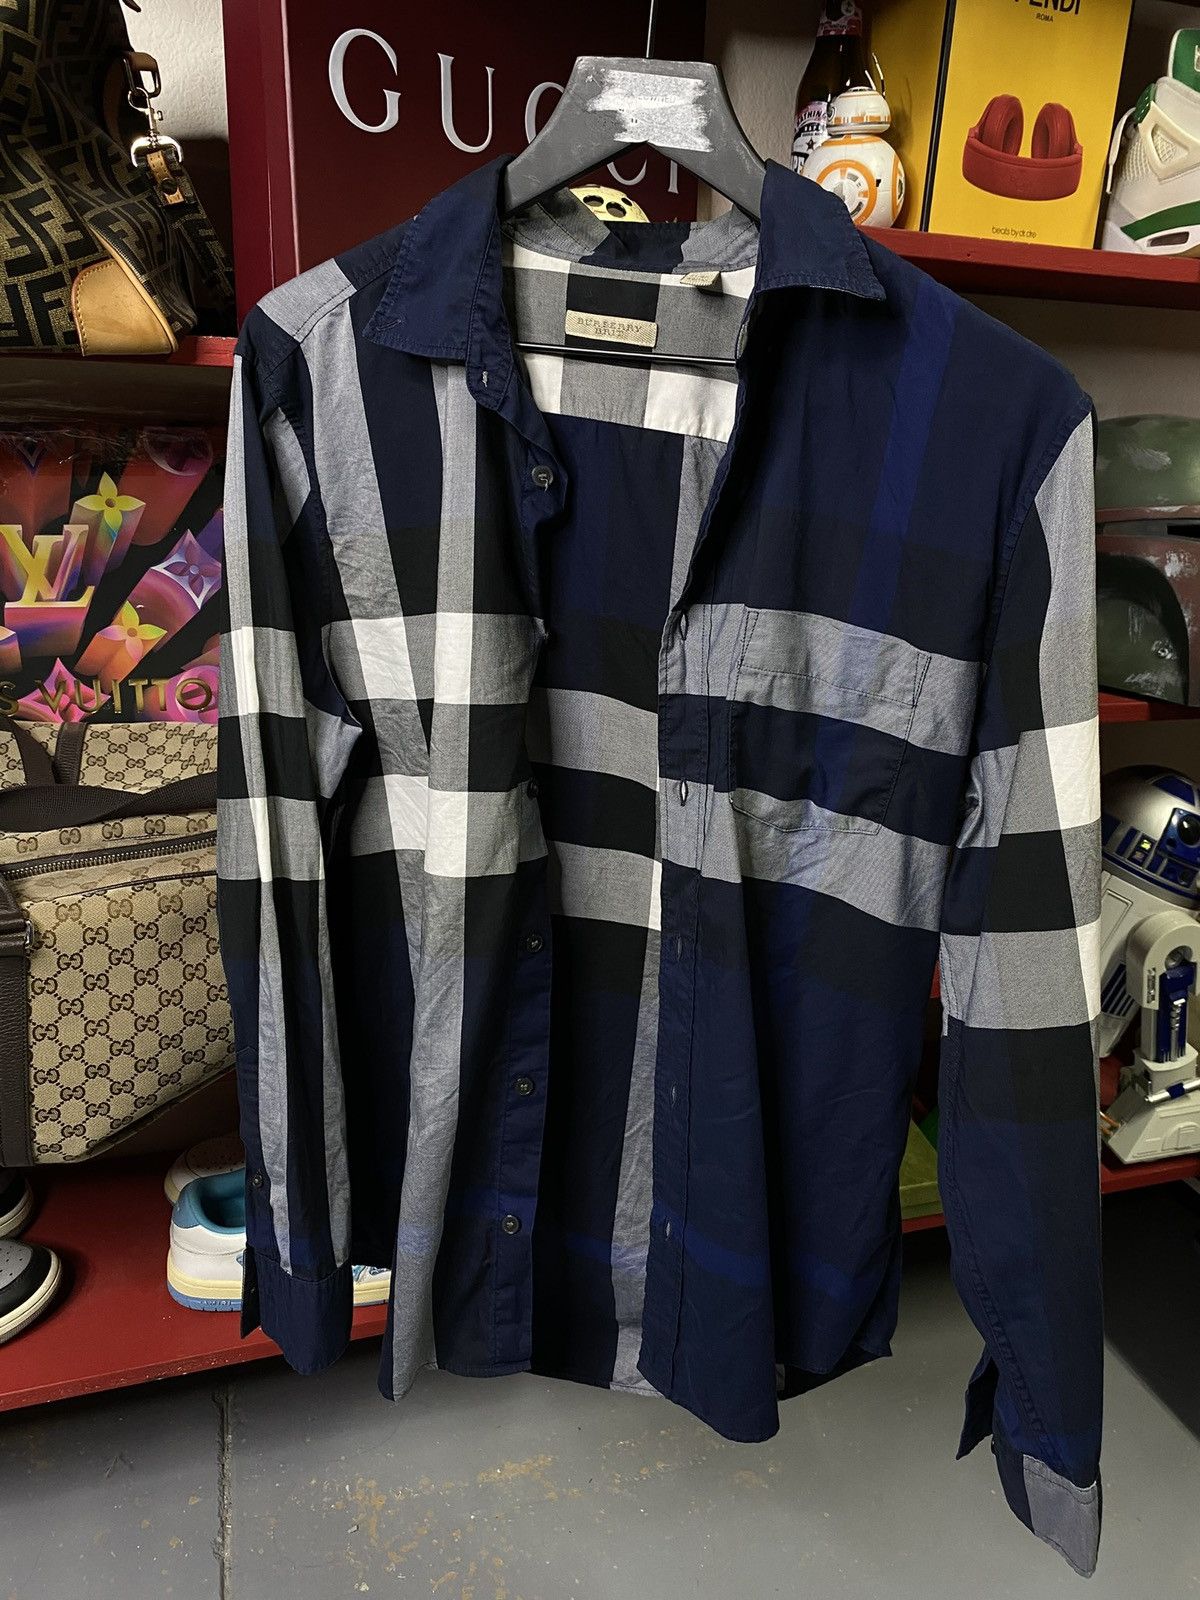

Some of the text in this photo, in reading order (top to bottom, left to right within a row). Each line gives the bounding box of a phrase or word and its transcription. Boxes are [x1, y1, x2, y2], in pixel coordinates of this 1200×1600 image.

[1036, 12, 1054, 22] ROMA
[991, 226, 1010, 236] beats
[577, 317, 642, 333] BURBERRY
